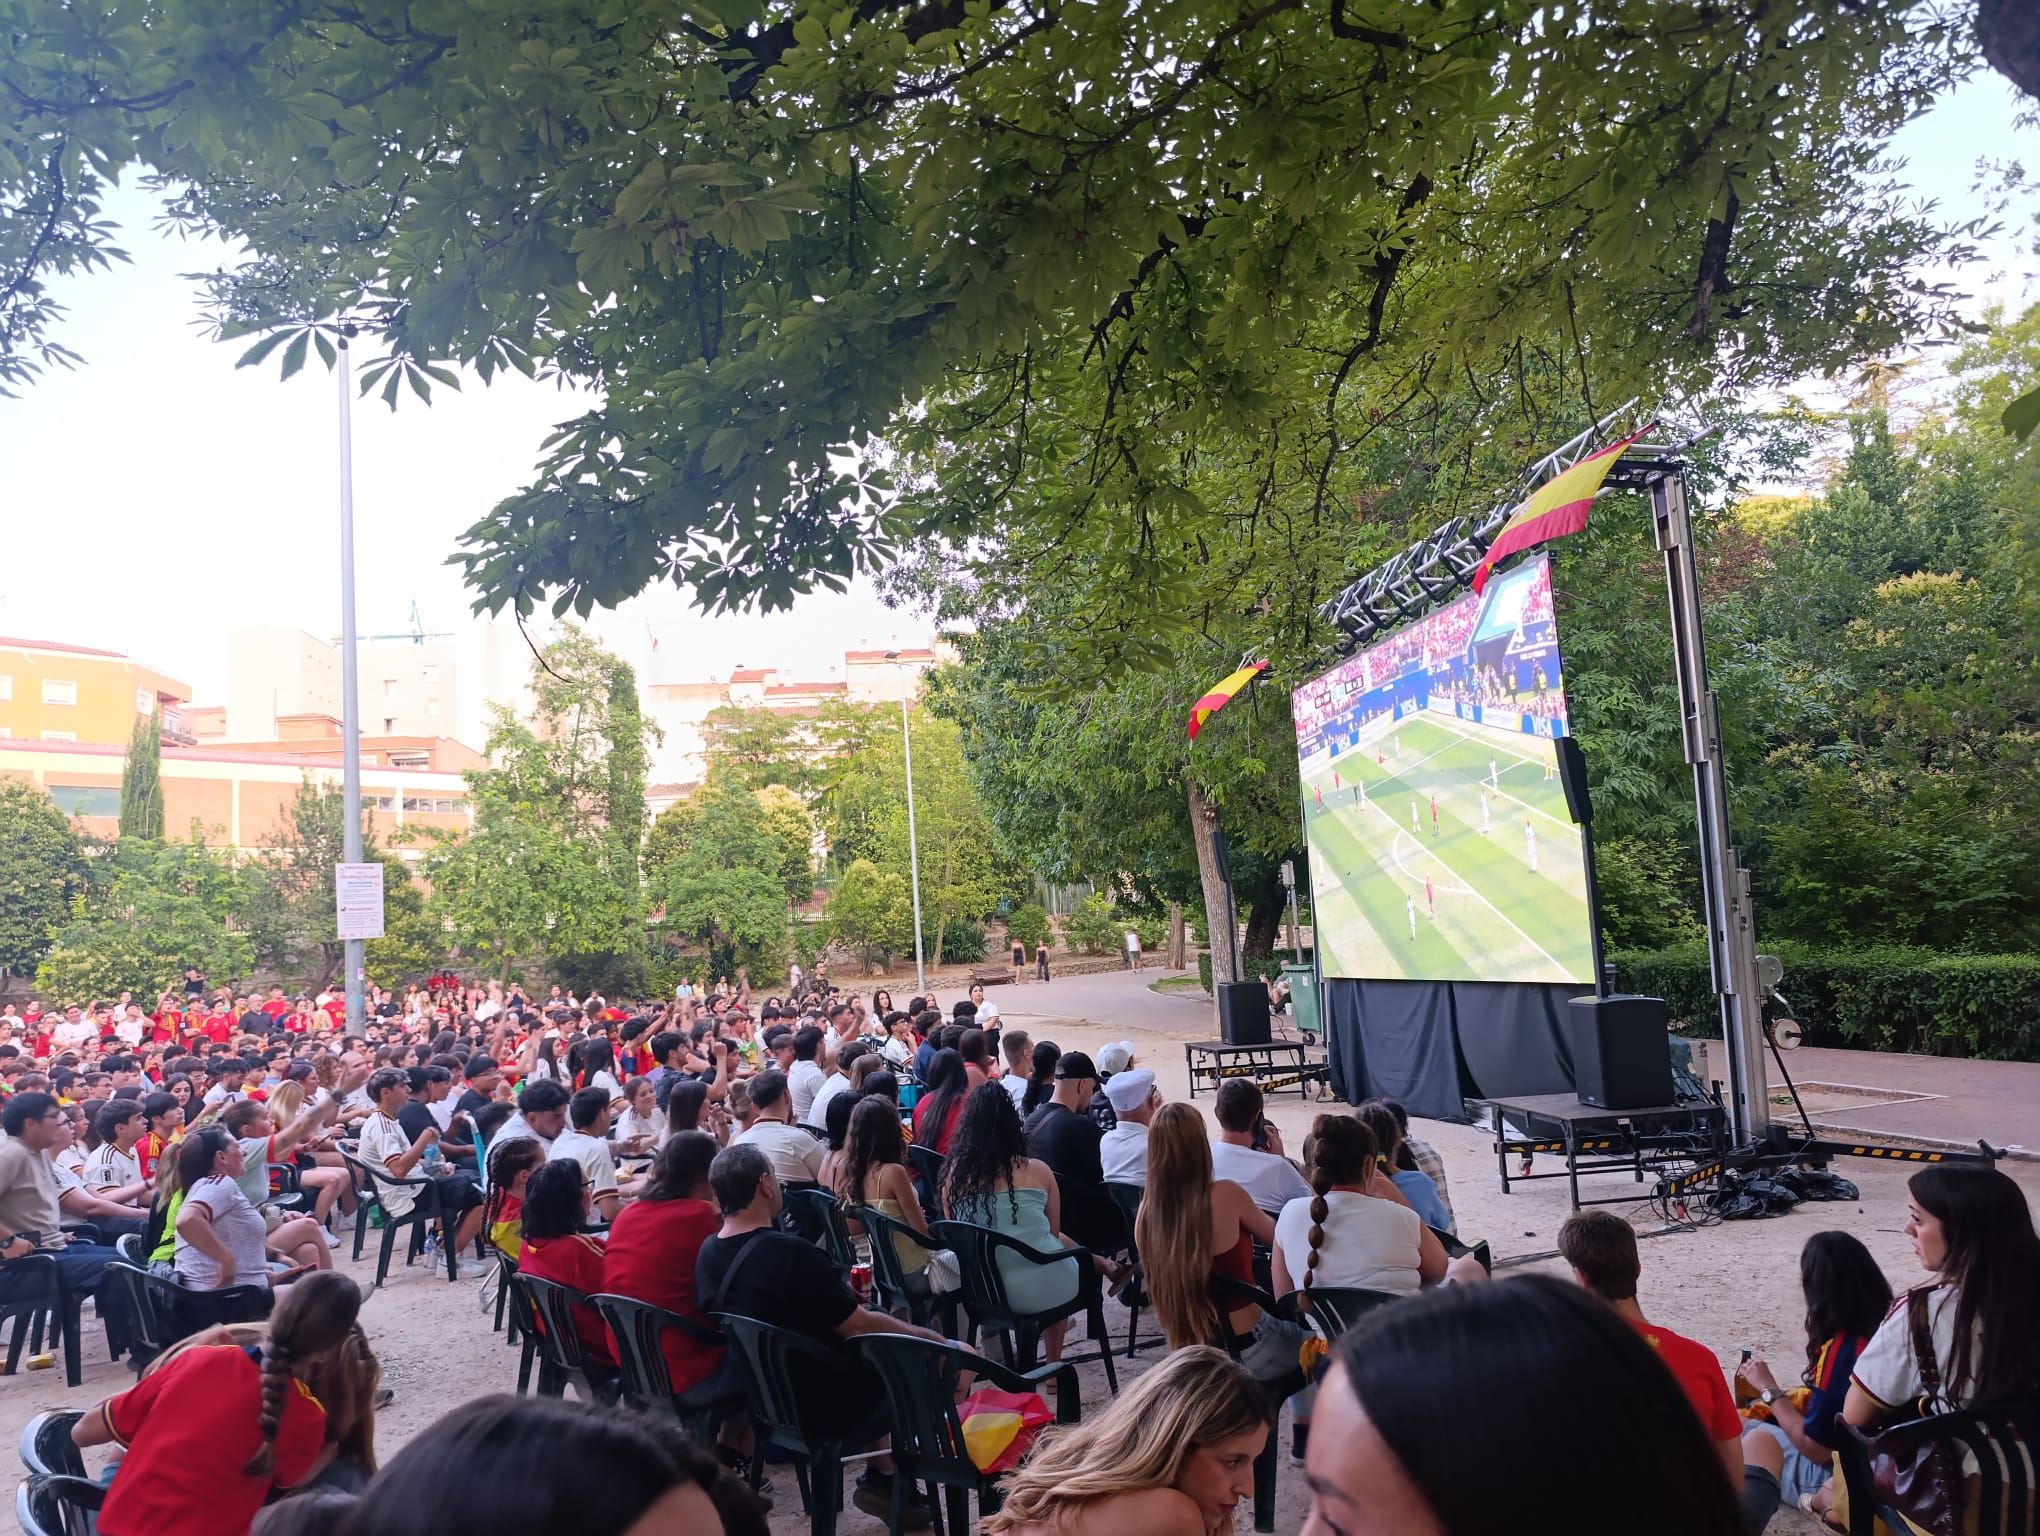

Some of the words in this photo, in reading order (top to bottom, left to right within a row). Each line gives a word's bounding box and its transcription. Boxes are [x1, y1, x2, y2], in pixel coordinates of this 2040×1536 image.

[1401, 696, 1418, 715] VISA
[1461, 703, 1475, 720] VISA
[1532, 715, 1553, 738] VISA
